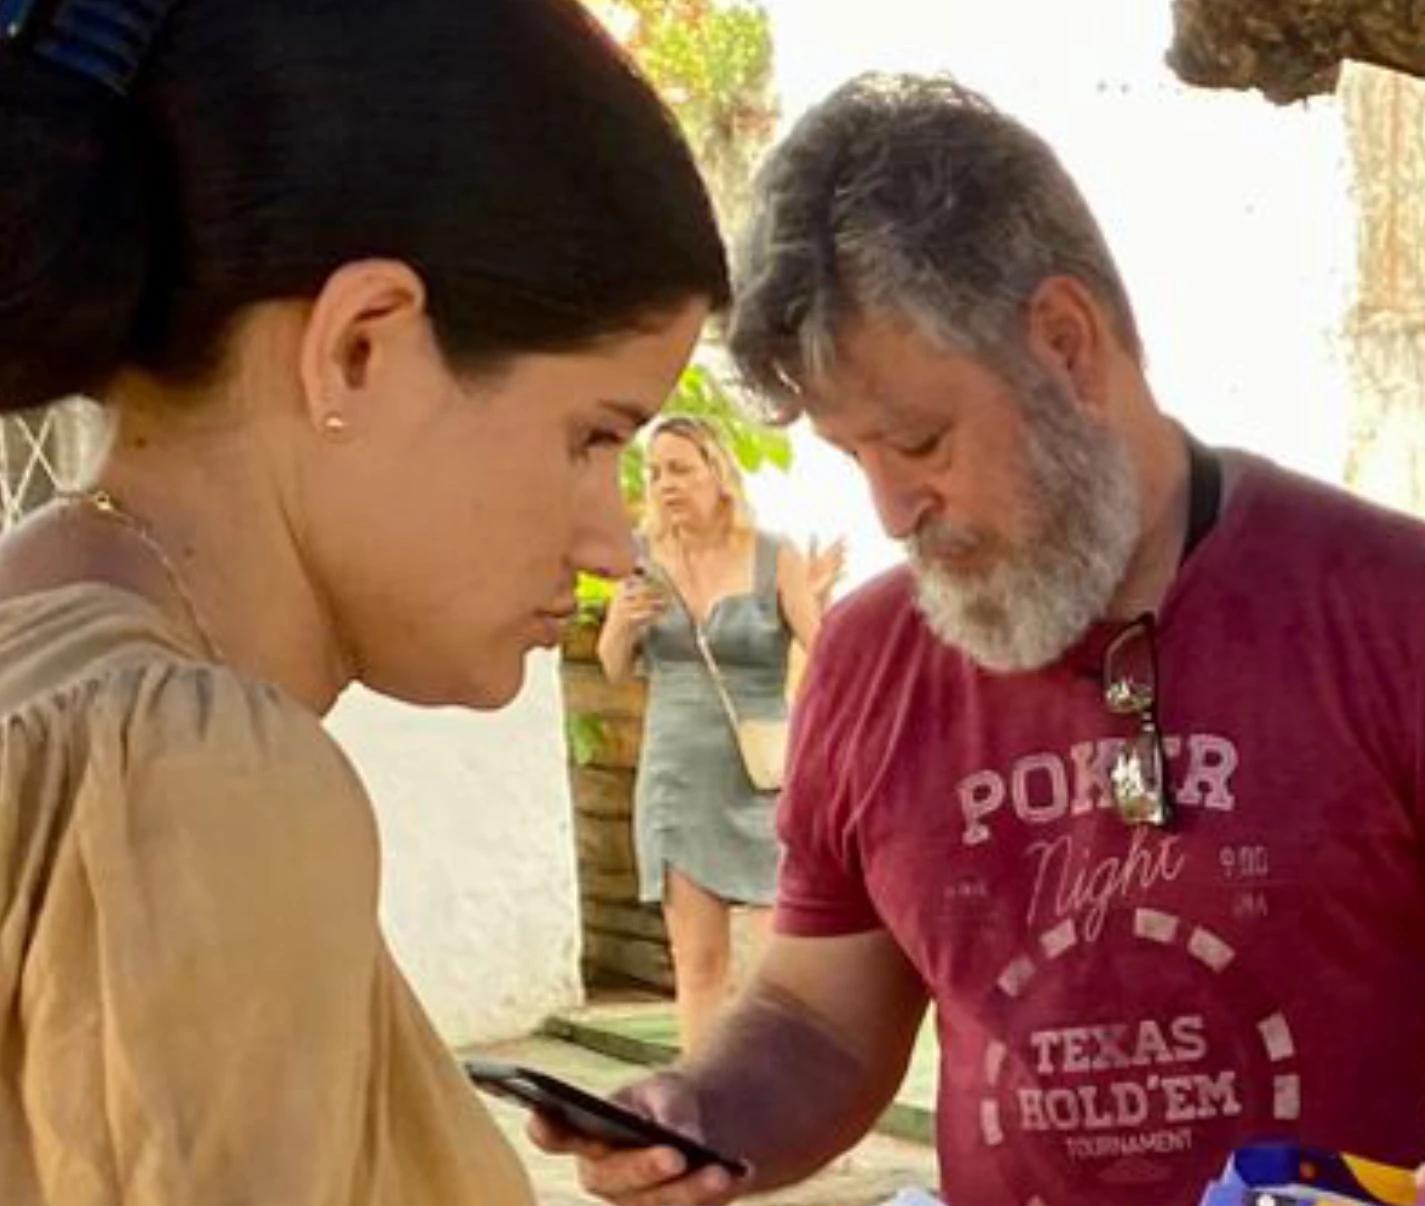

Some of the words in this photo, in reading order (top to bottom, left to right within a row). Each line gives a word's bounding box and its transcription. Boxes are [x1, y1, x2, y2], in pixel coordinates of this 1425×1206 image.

[956, 733, 1239, 845] POKR
[1025, 824, 1185, 942] Night
[1029, 1015, 1208, 1075] TEXAS
[1016, 1069, 1243, 1131] HOLD'EM
[1066, 1126, 1193, 1162] TOURNAMENT
